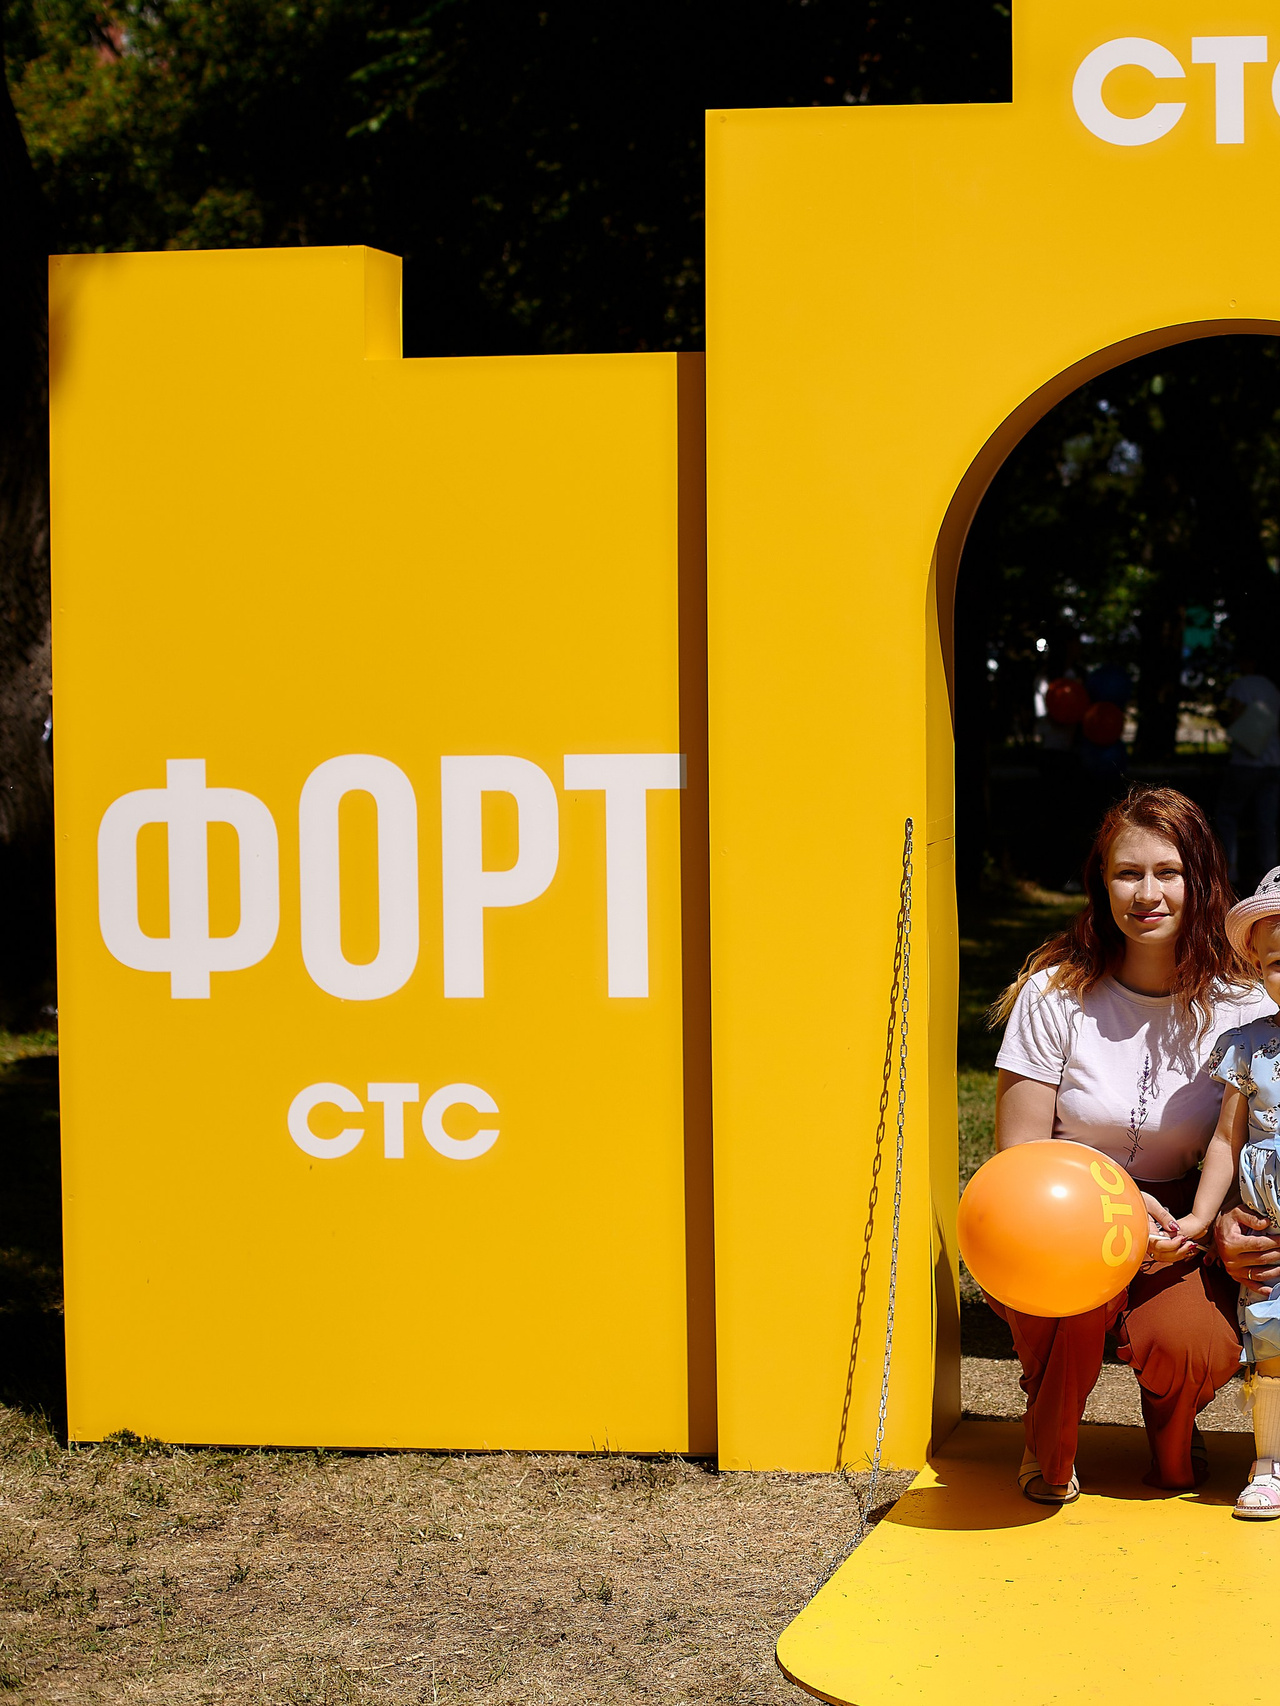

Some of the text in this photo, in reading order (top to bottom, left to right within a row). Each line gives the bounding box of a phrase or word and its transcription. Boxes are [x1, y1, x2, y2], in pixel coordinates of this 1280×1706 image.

[97, 753, 688, 1001] ФОРТ
[287, 1082, 500, 1160] СТС
[1089, 1160, 1134, 1267] СТС
